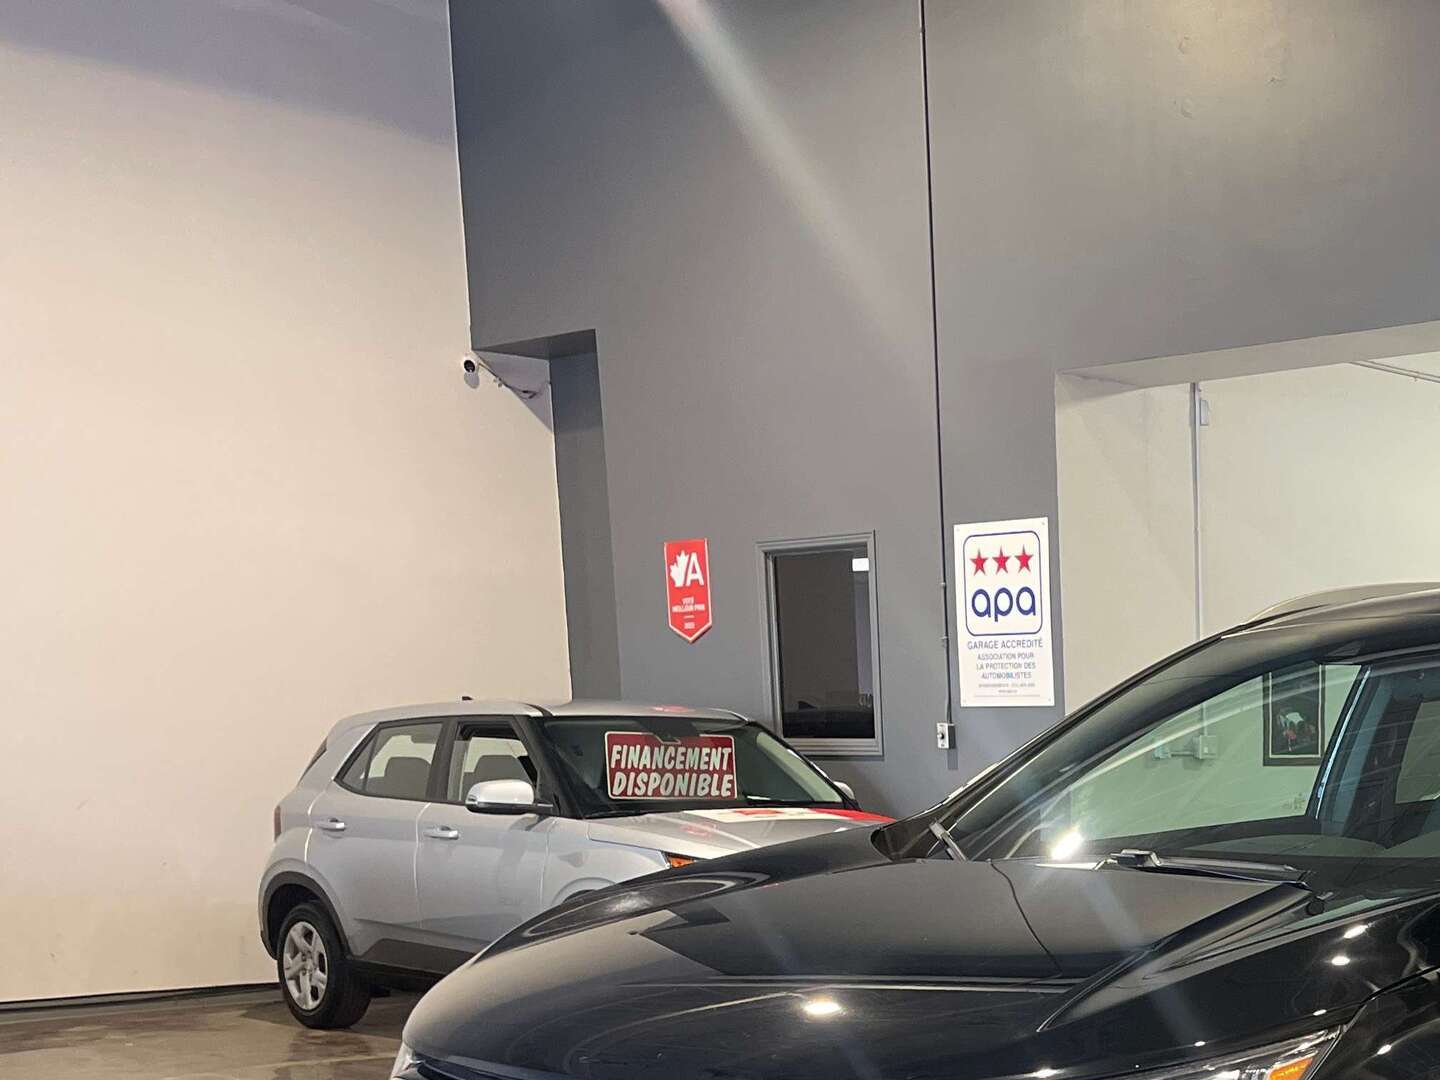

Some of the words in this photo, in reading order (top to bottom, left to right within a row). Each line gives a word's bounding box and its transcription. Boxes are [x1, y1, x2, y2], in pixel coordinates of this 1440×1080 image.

[971, 586, 1036, 622] apa
[967, 640, 999, 650] GARAGE
[977, 652, 1017, 661] ASSOCIATION
[1017, 652, 1035, 660] POUR
[976, 663, 985, 671] LA
[985, 662, 1023, 670] PROTECTION
[1023, 661, 1037, 669] DES
[981, 671, 1032, 680] AUTOMOBILISTES
[610, 744, 732, 771] FINANCEMENT
[612, 771, 733, 797] DISPONIBLE
